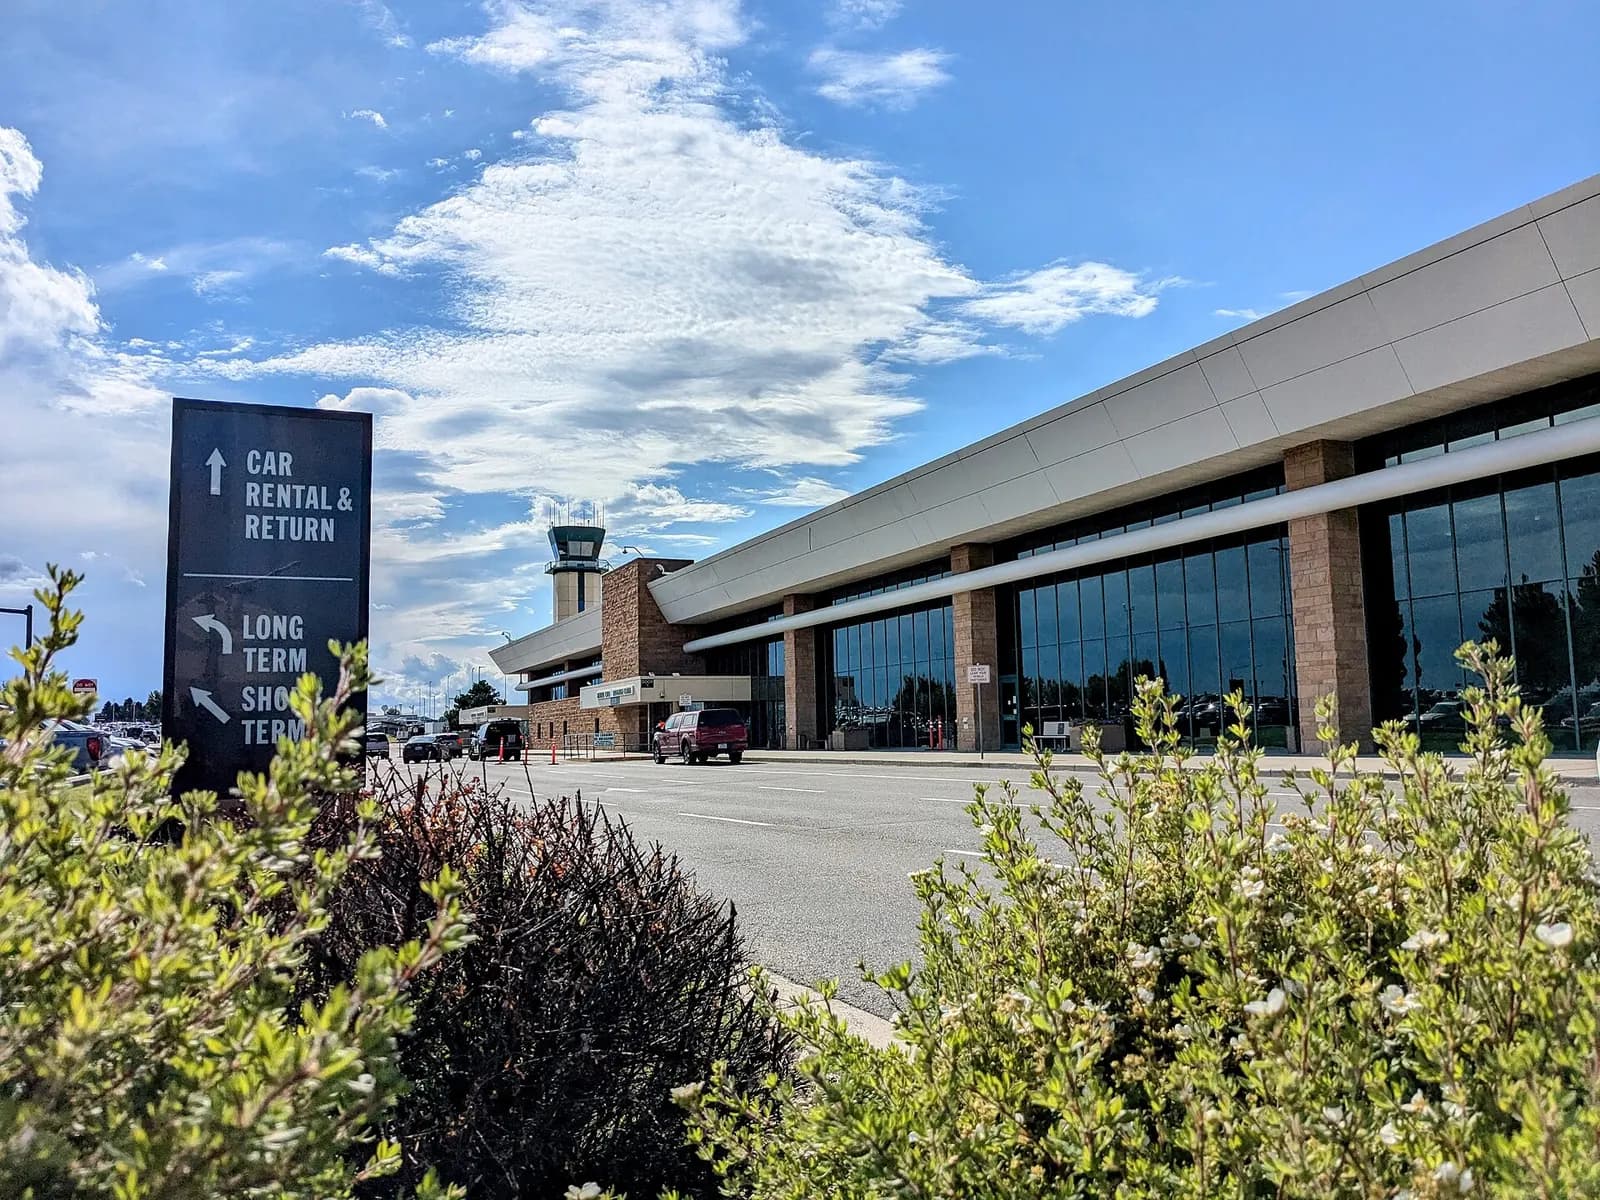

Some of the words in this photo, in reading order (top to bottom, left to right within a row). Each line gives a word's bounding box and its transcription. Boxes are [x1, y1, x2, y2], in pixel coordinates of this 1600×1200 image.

[246, 449, 293, 476] CAR
[246, 482, 333, 510] RENTAL
[337, 487, 353, 511] &
[245, 514, 335, 542] RETURN
[243, 614, 304, 640] LONG
[242, 647, 307, 673] TERM
[241, 686, 299, 712] SHO
[241, 719, 306, 745] TERM
